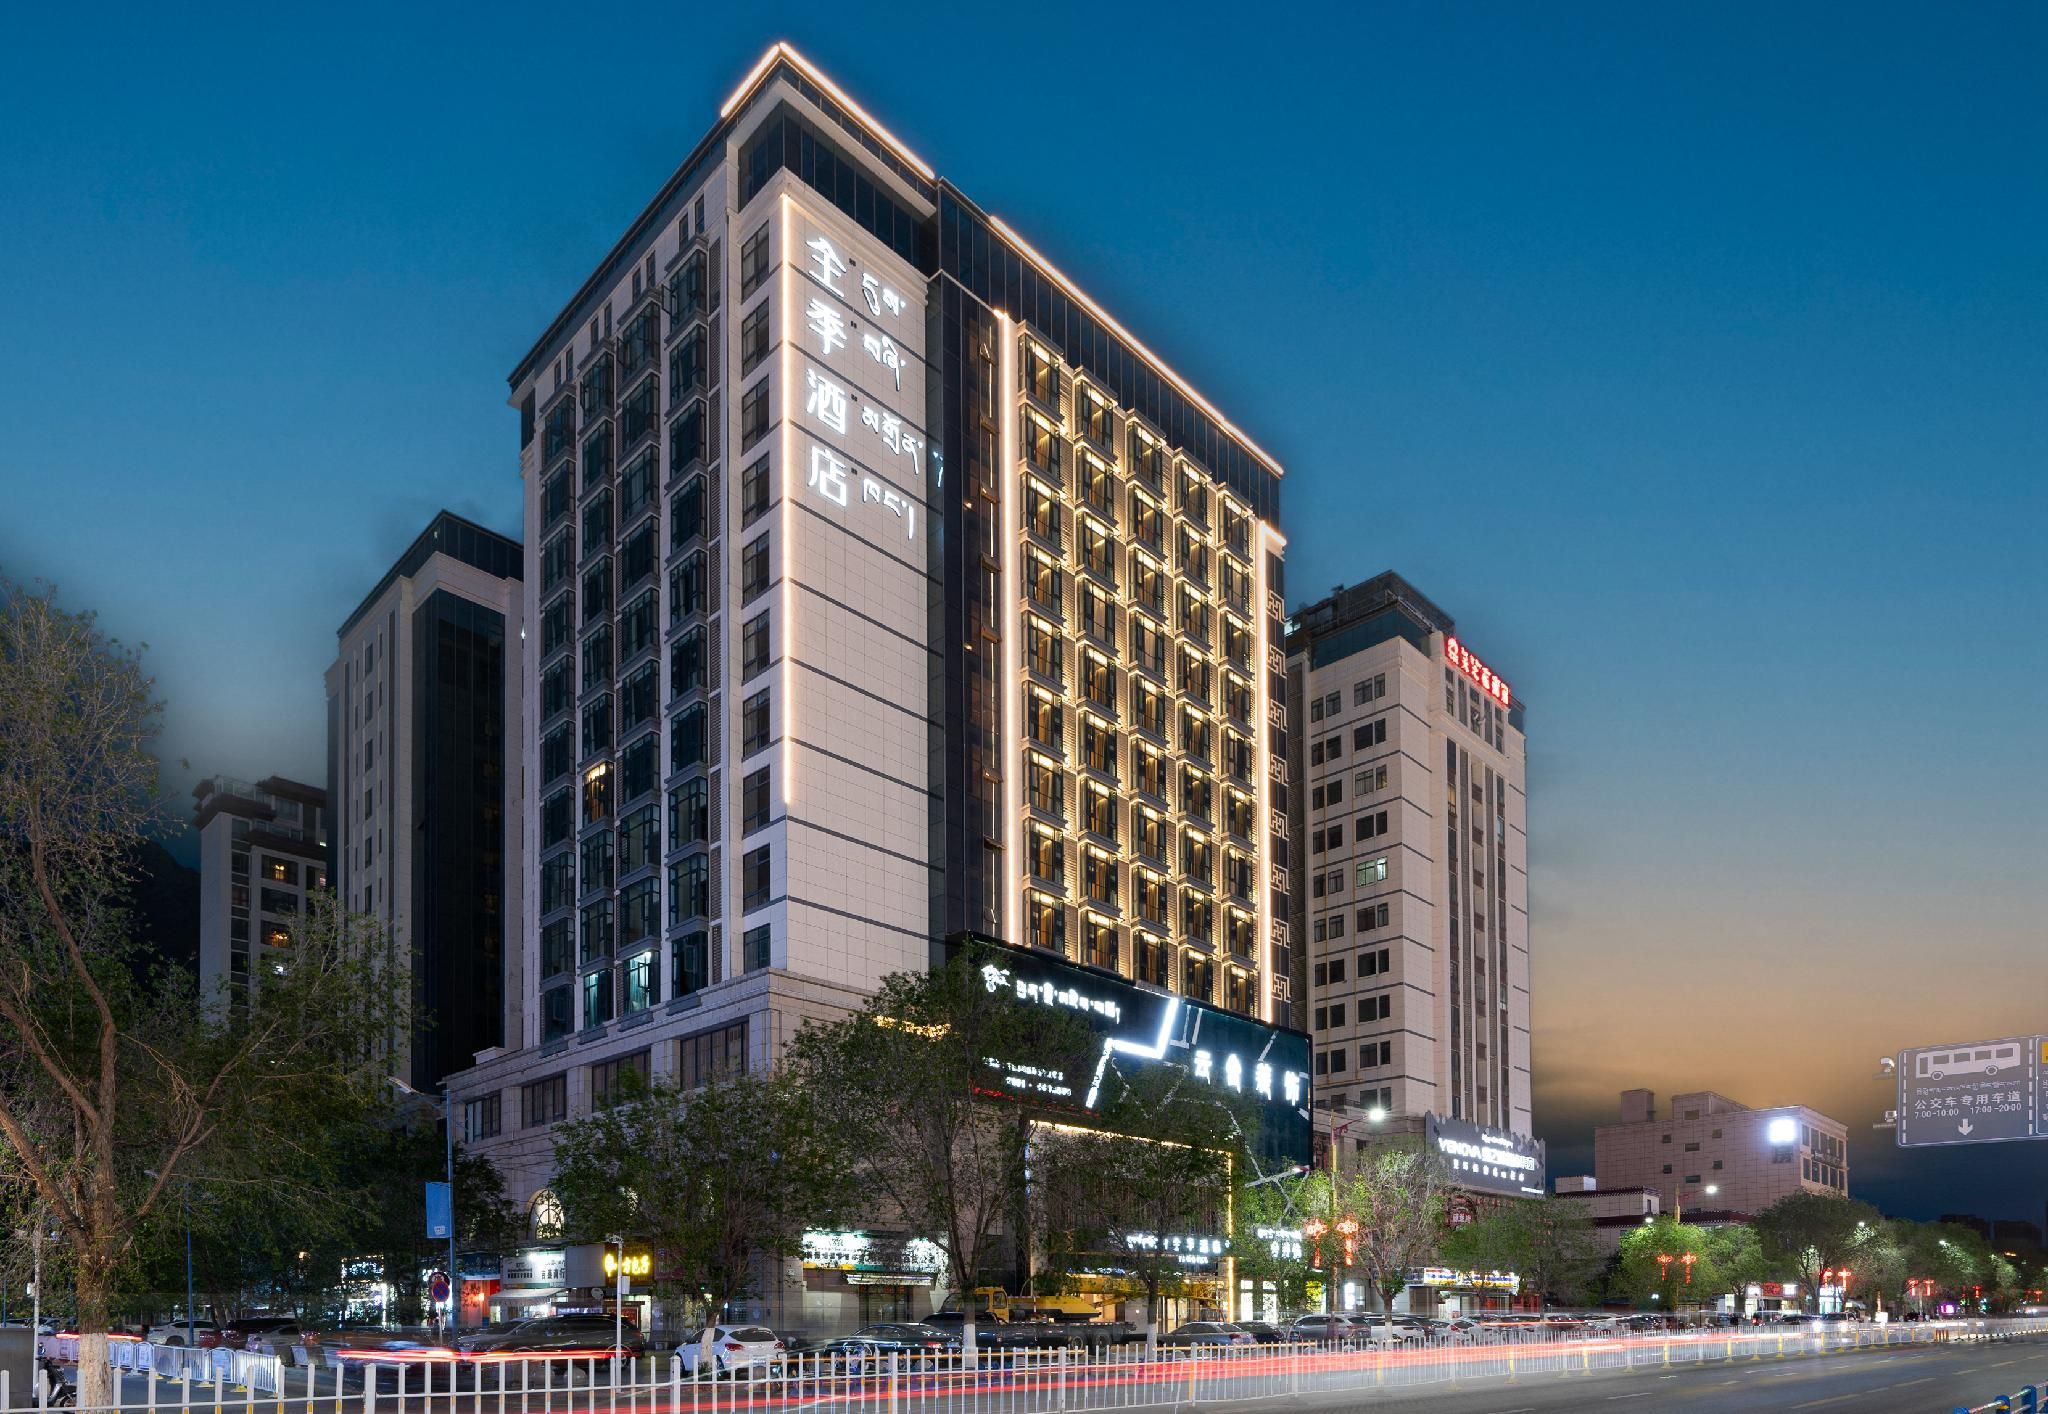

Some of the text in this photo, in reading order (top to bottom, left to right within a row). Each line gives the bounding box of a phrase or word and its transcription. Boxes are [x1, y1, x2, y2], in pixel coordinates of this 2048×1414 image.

[806, 237, 847, 507] 全季酒店
[1914, 1090, 2021, 1110] 公交车专用车道
